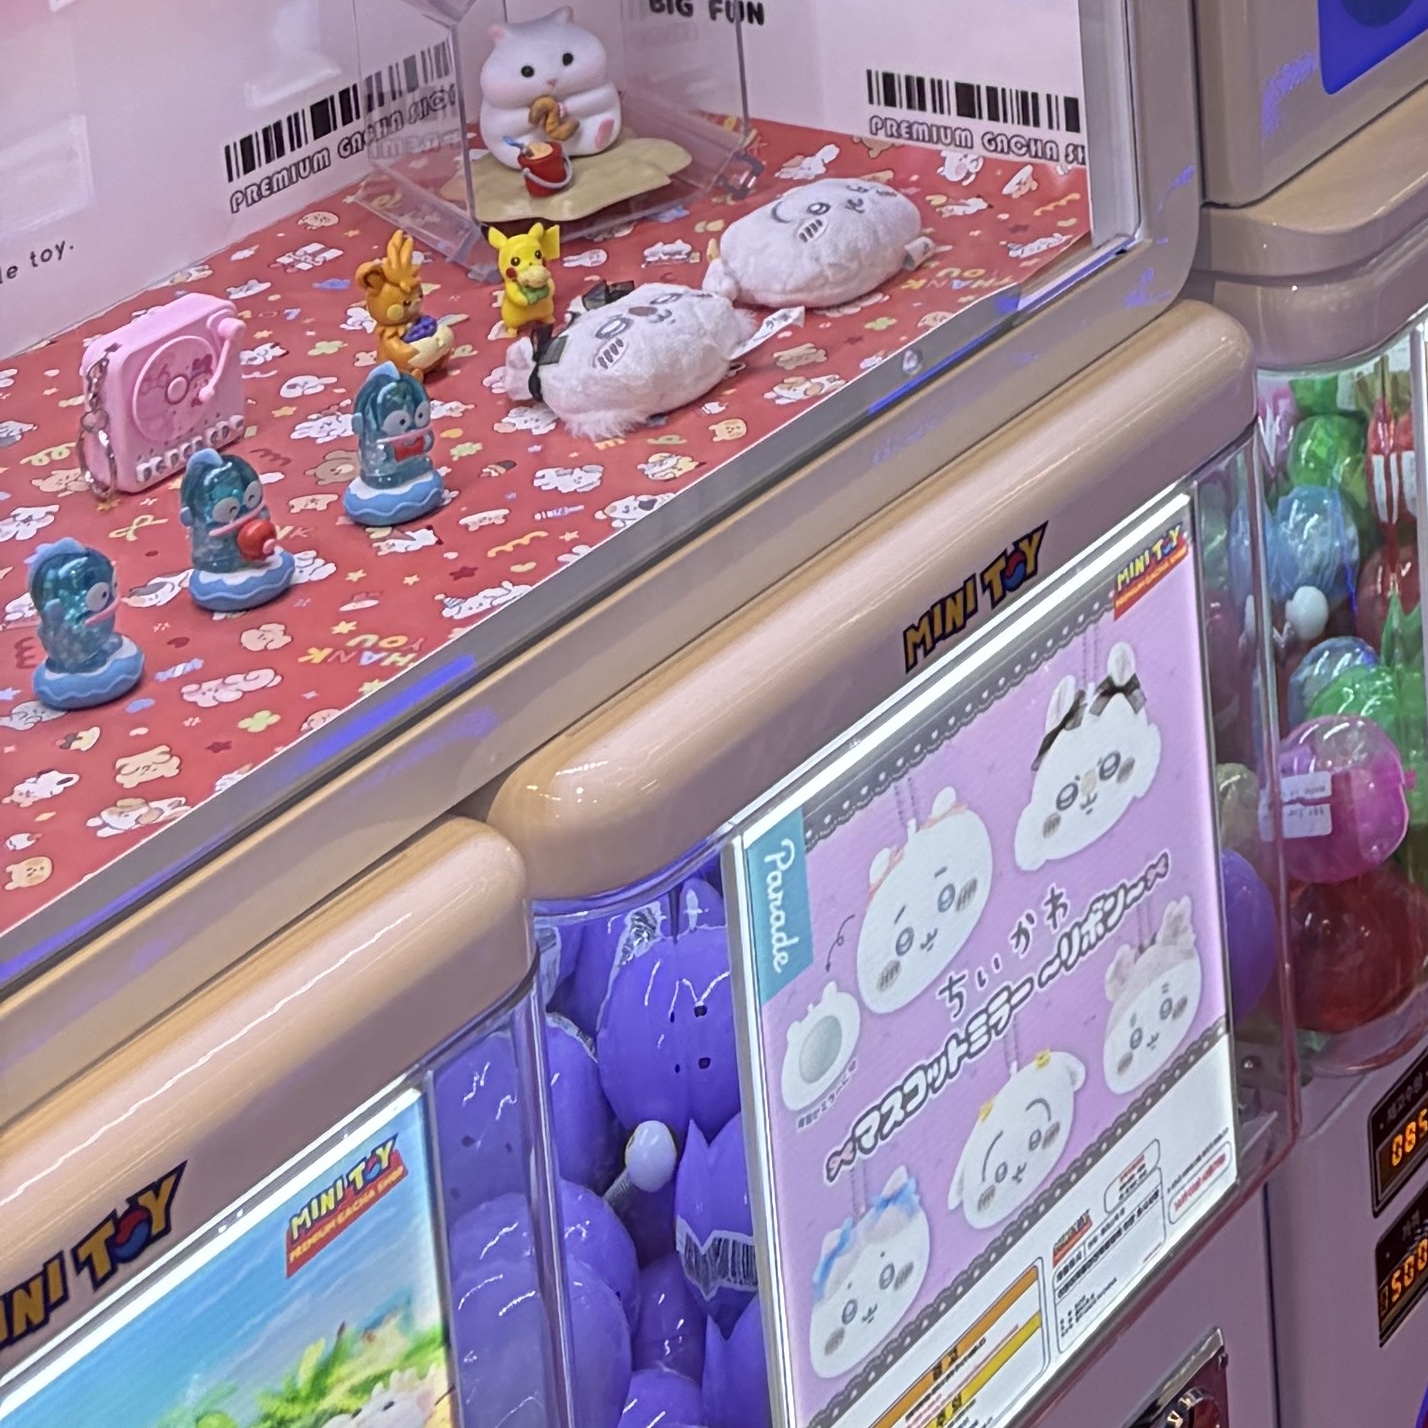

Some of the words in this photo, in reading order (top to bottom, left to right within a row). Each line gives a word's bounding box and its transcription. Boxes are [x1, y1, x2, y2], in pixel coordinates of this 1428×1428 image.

[229, 147, 331, 214] PREMIUM
[336, 109, 404, 160] GACHA
[868, 114, 975, 150] PREMIUM
[980, 131, 1060, 165] GACHA
[29, 240, 74, 268] toy.
[903, 572, 979, 675] MINI
[979, 519, 1050, 611] TOY
[1116, 550, 1150, 591] MINI
[763, 837, 800, 975] Parade
[937, 882, 1069, 1020] ちいかわ
[71, 1158, 188, 1291] TOY
[288, 1174, 345, 1242] MINI
